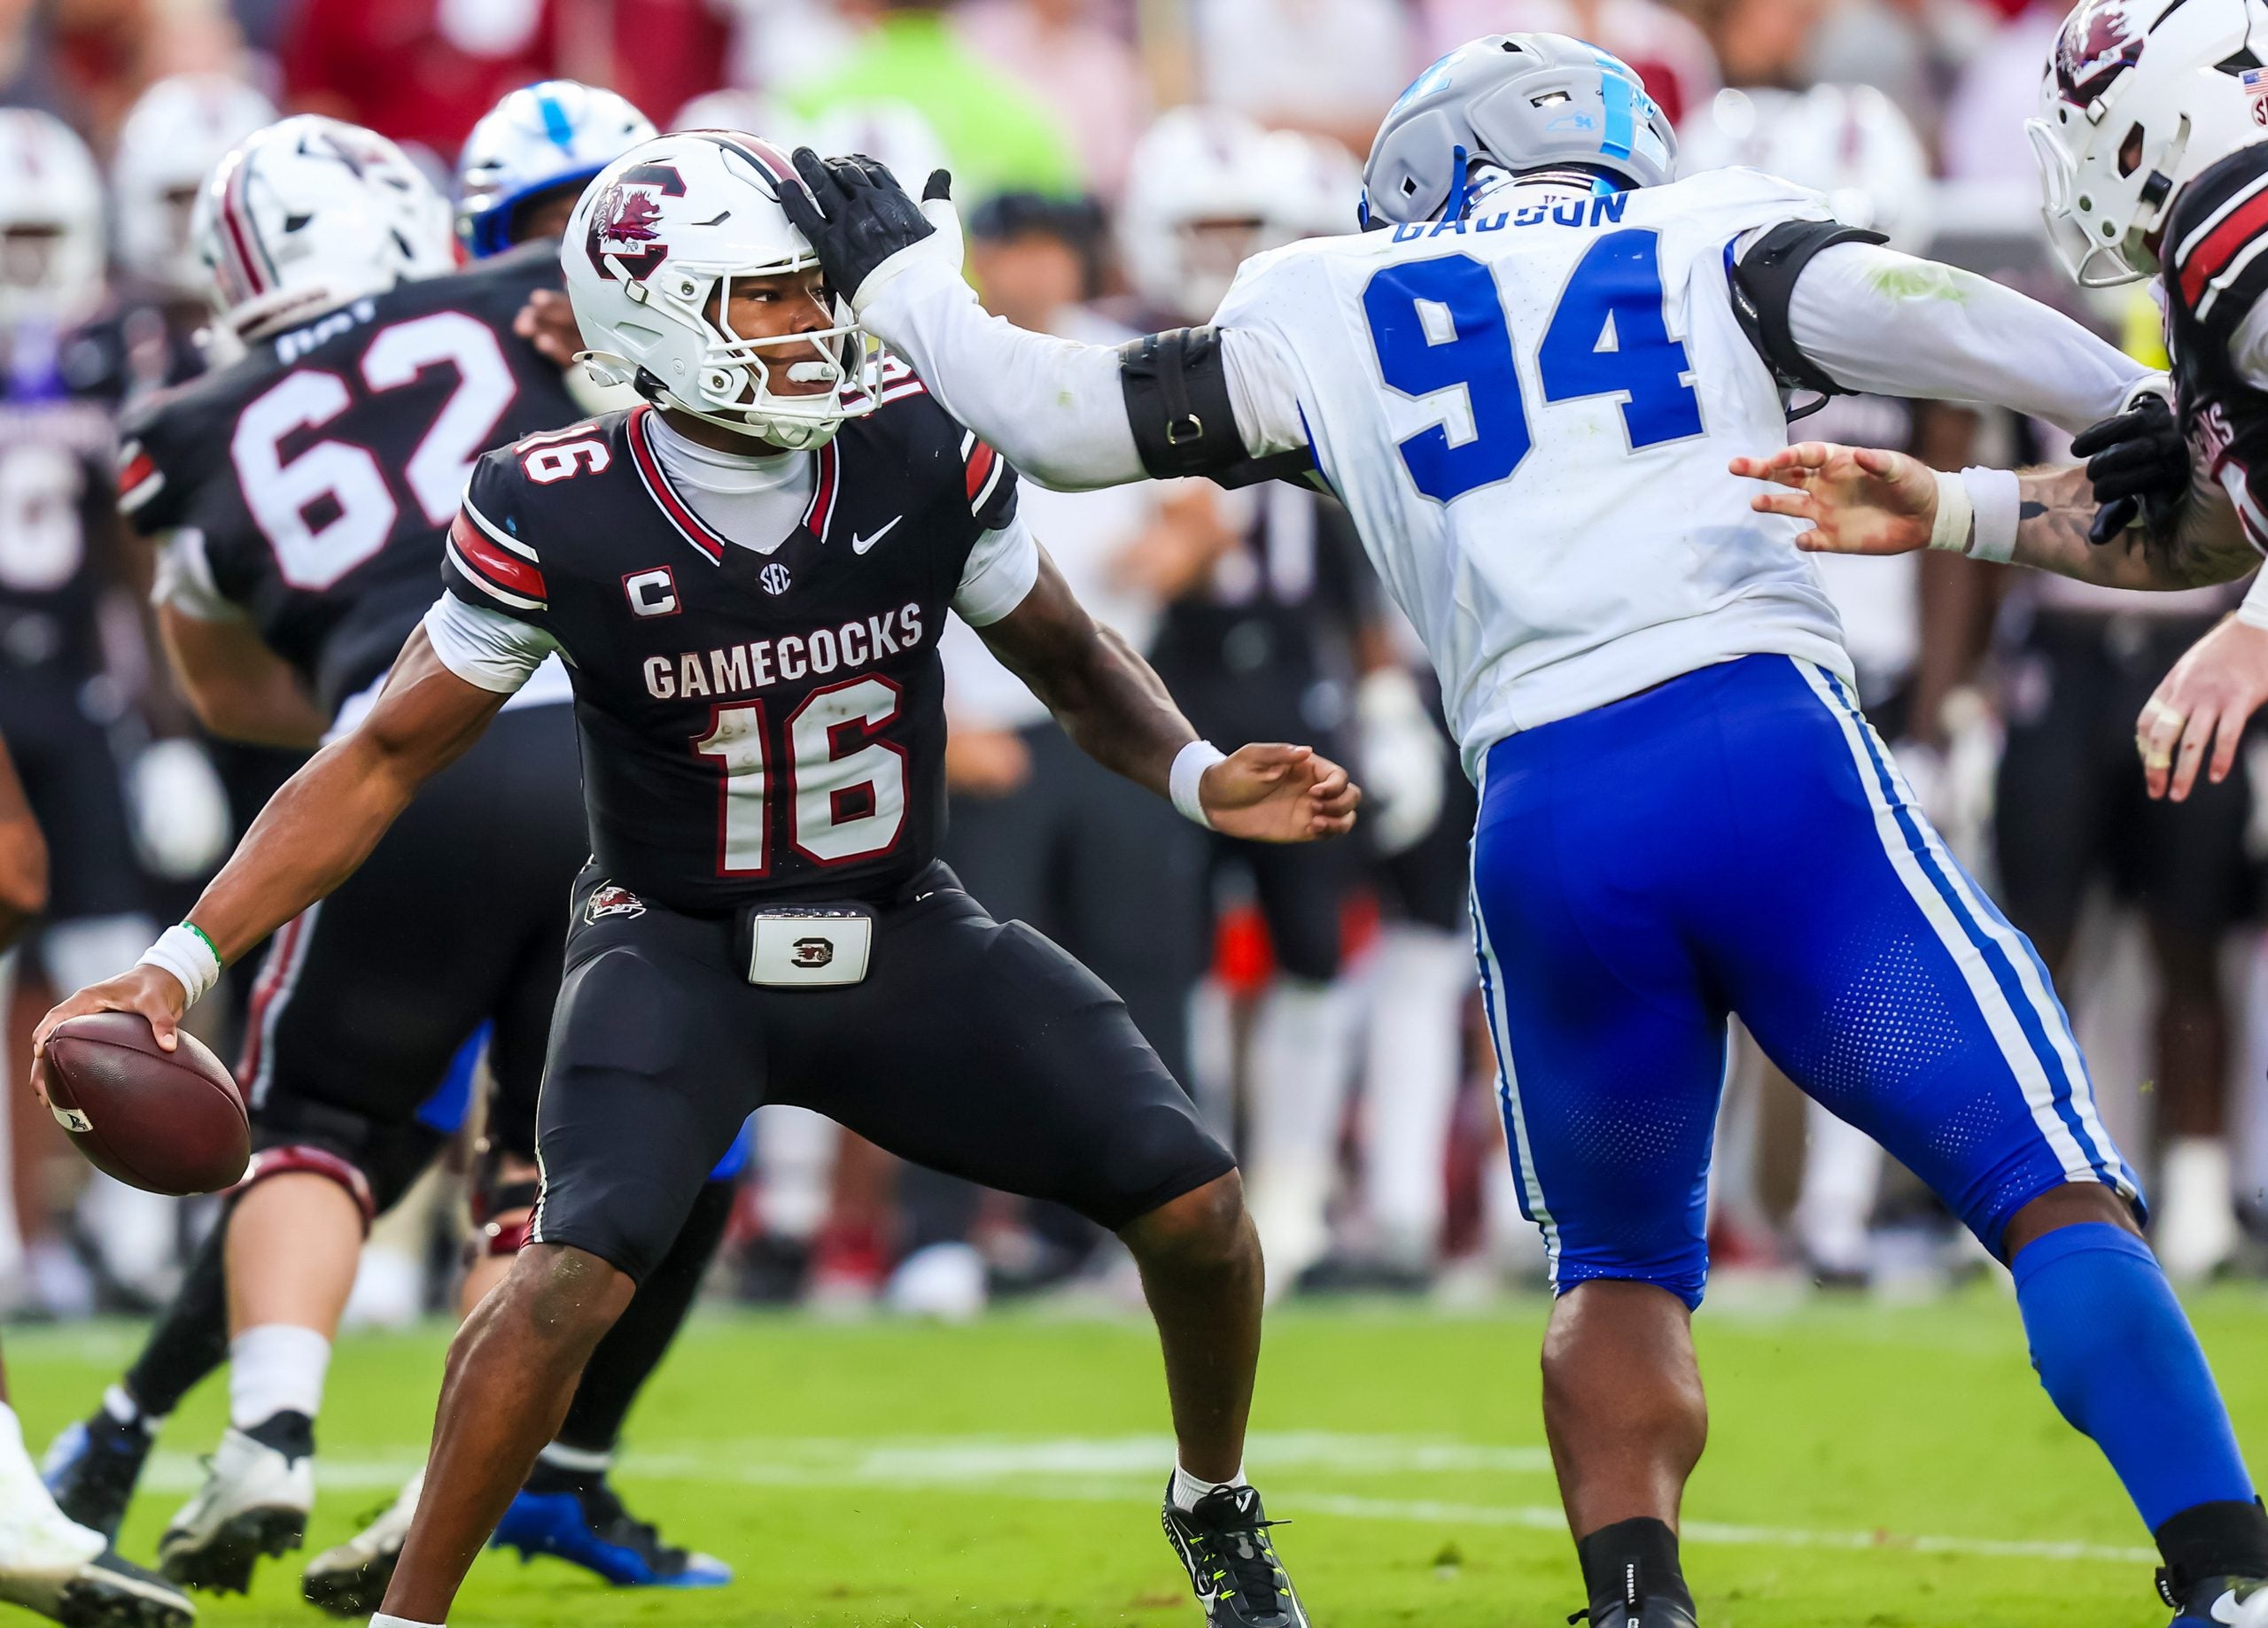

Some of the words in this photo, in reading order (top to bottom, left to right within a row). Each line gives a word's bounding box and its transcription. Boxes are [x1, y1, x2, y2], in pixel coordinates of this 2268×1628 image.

[1357, 225, 1710, 509] 94
[232, 311, 517, 591] 62
[513, 424, 613, 485] 16
[626, 570, 676, 617] C
[760, 563, 791, 595] SEC
[643, 602, 922, 699] GAMECOCKS
[689, 672, 909, 877] 16
